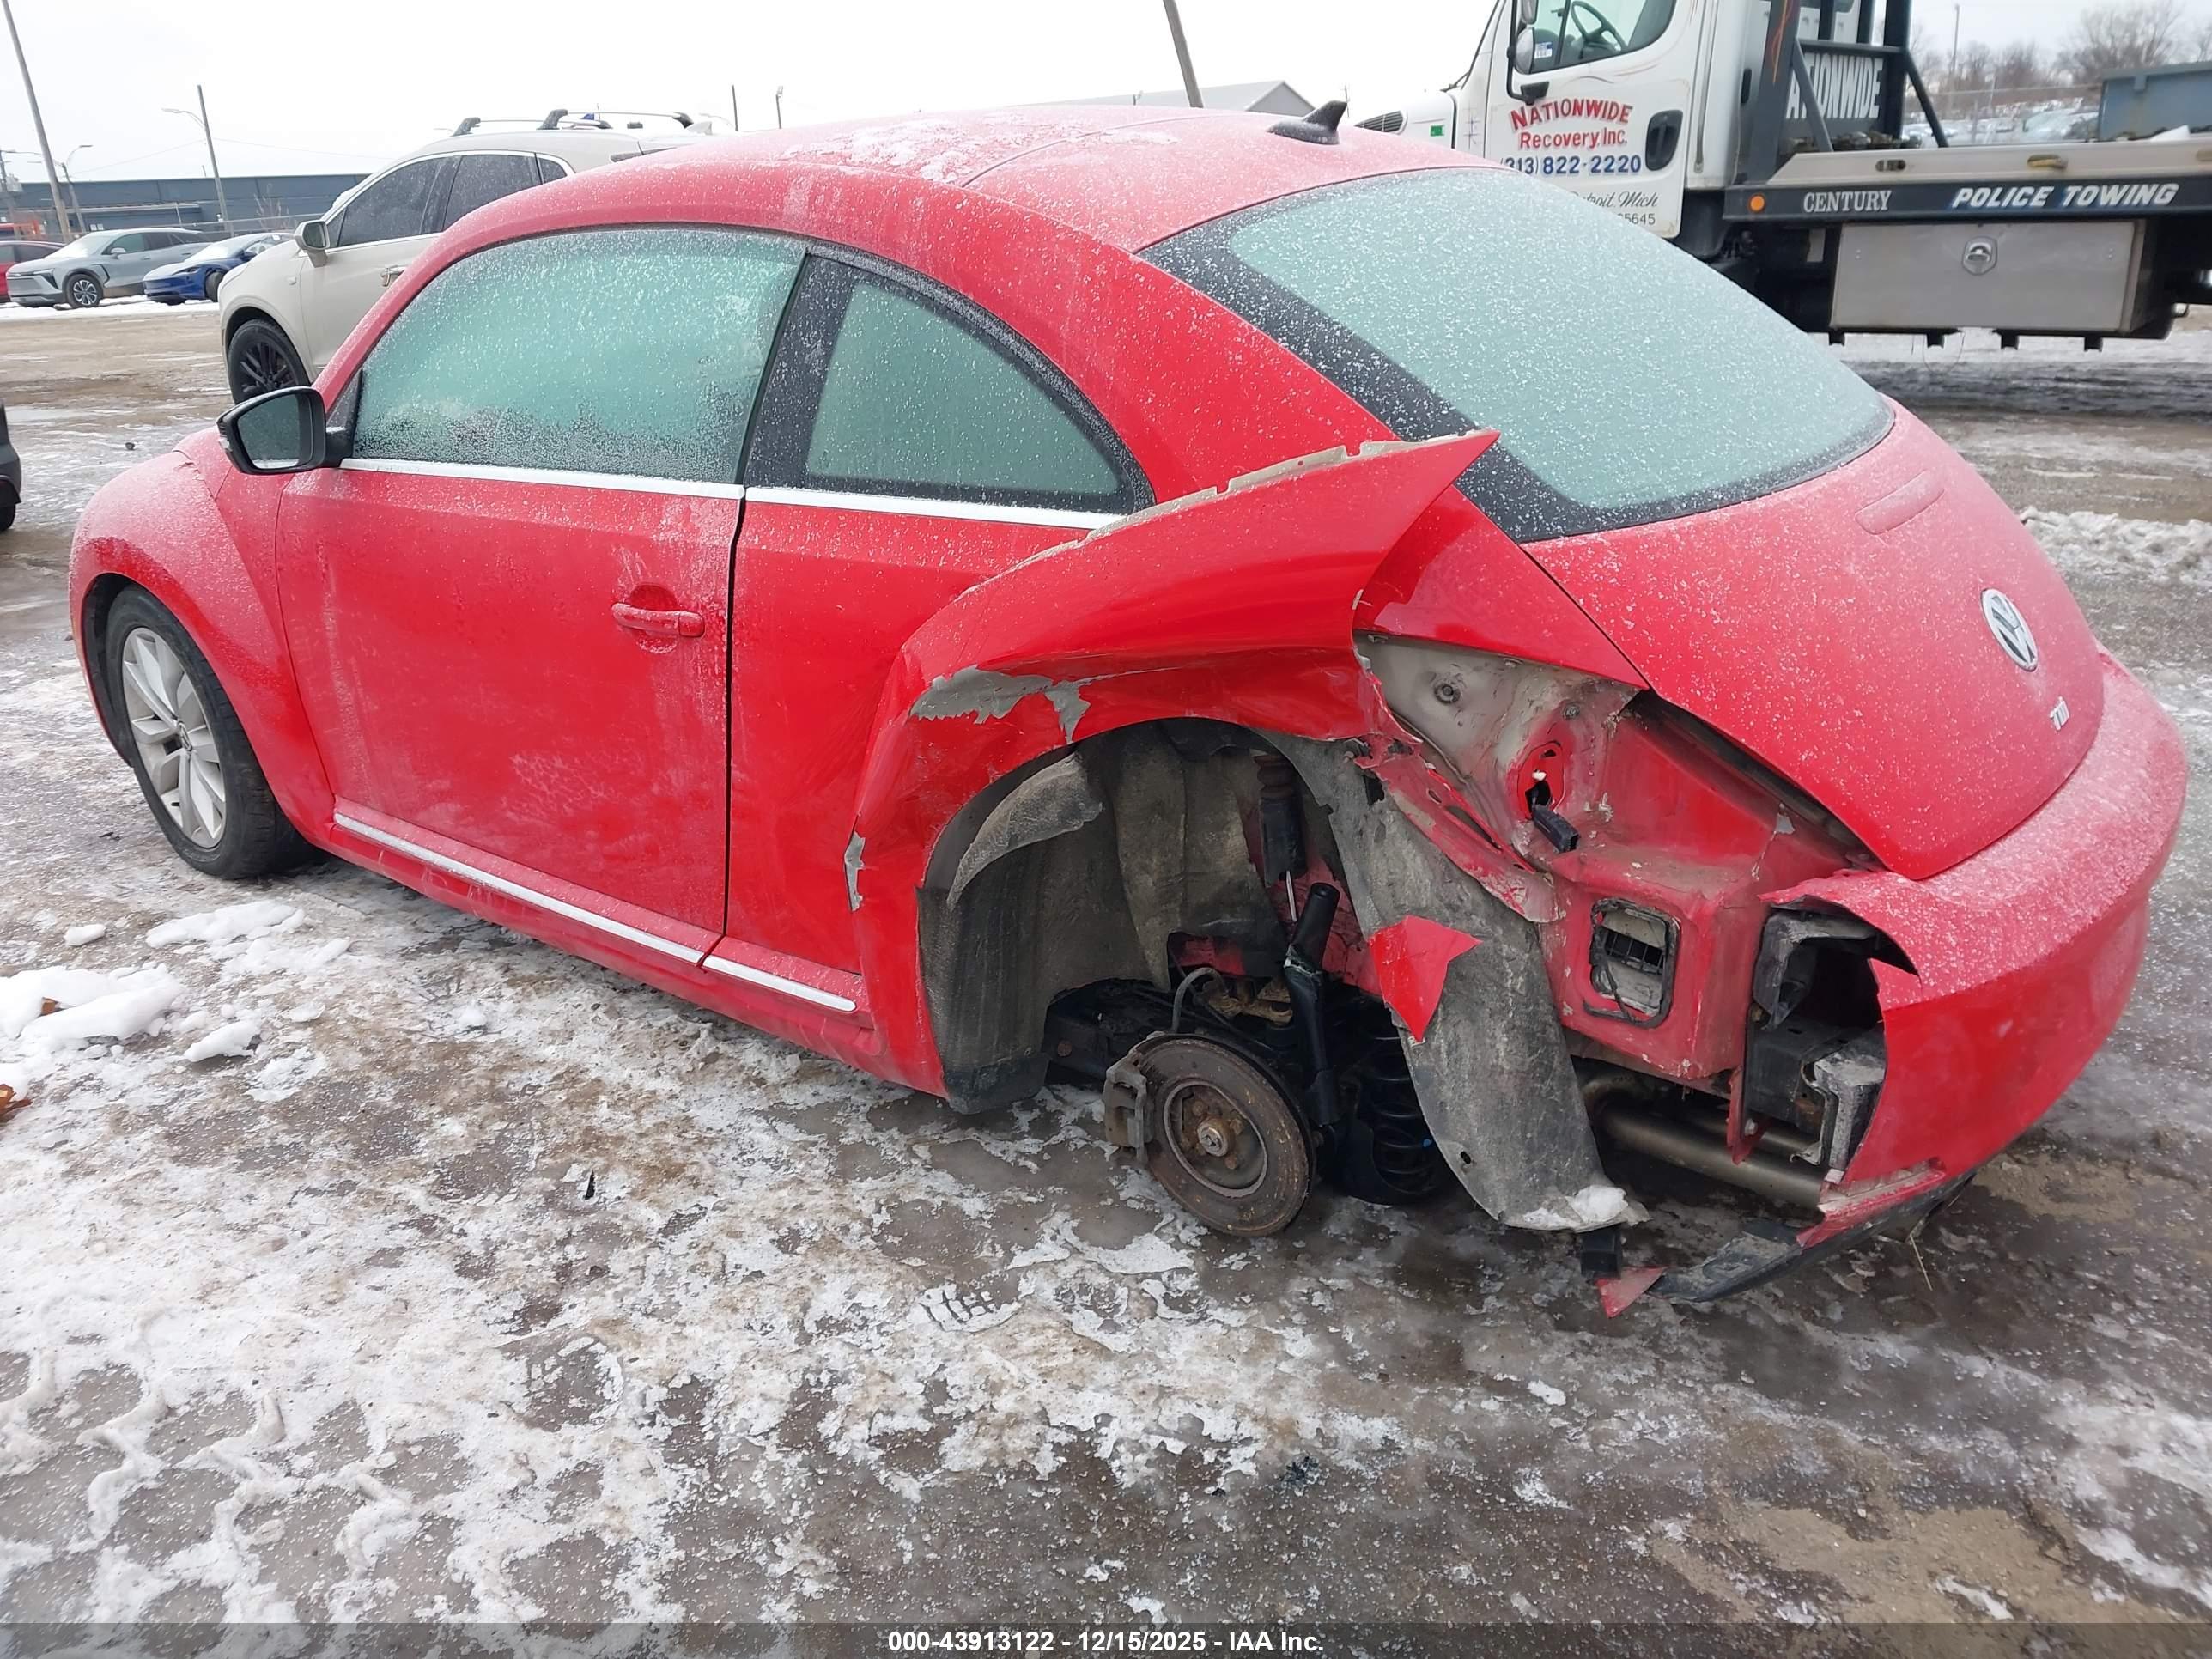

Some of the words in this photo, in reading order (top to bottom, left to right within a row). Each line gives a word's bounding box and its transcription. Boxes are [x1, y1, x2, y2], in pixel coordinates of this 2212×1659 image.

[1786, 52, 1884, 119] ATIONWIDE
[1510, 98, 1633, 131] NATIONWIDE
[1602, 127, 1628, 145] Inc.
[1803, 189, 1892, 213] CENTURY
[1951, 185, 2055, 209] POLICE
[2063, 183, 2180, 207] TOWING
